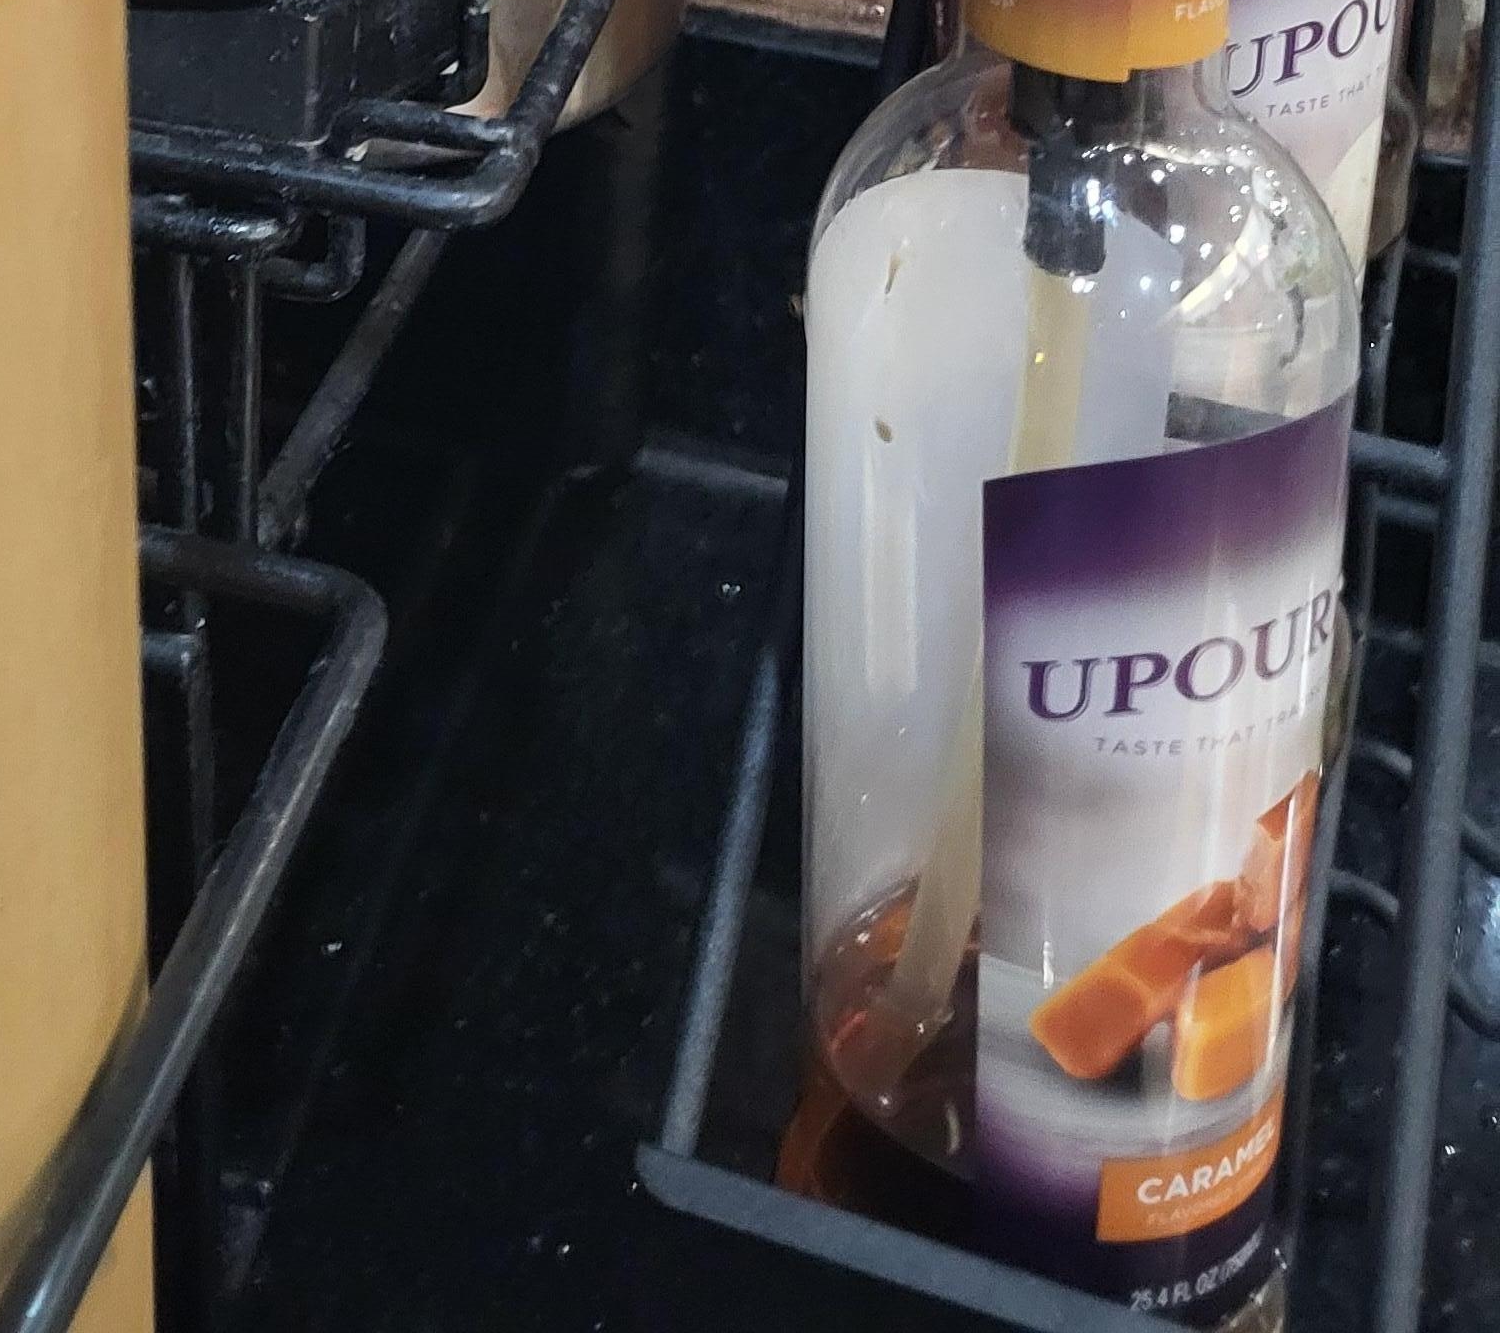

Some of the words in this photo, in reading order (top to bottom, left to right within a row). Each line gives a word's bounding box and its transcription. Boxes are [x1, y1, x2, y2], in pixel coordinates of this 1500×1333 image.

[1266, 94, 1331, 118] TASTE
[1095, 737, 1183, 757] TASTE
[1197, 725, 1255, 751] THAT
